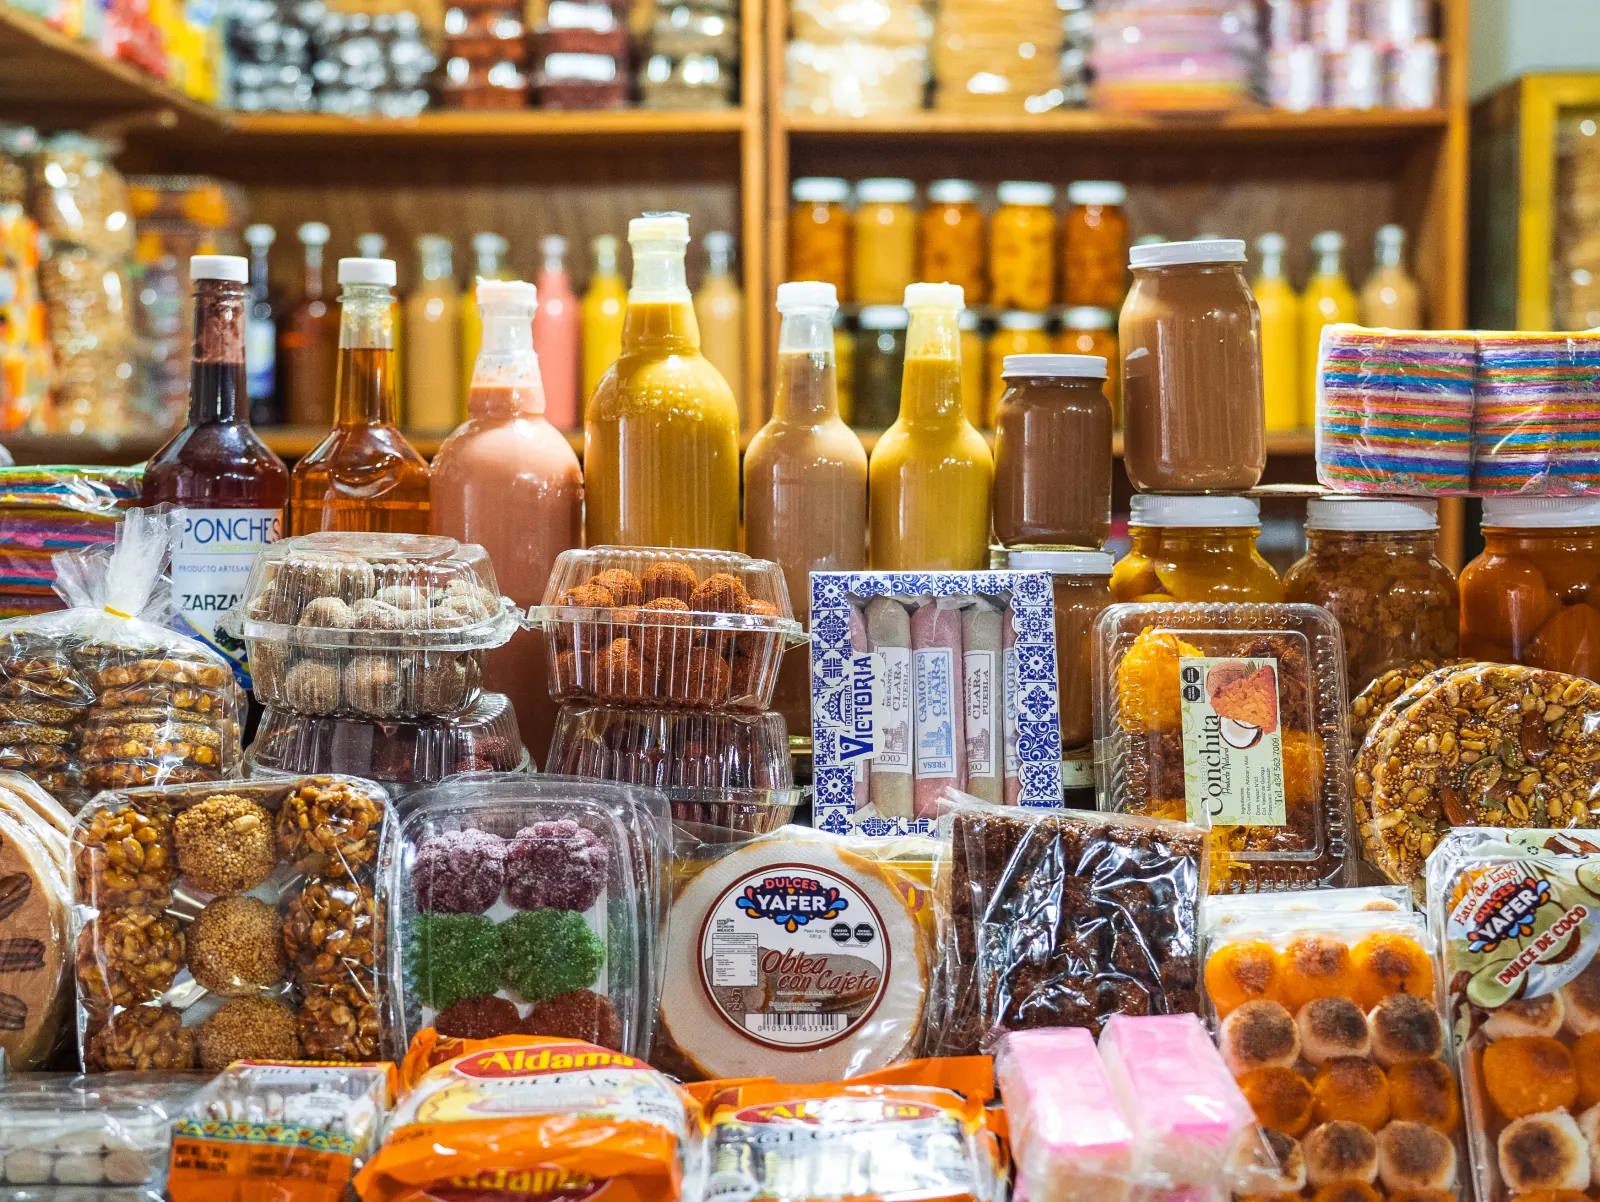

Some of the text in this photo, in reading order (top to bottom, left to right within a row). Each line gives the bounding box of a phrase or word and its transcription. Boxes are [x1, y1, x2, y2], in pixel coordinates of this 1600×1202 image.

[180, 518, 281, 549] PONCHES
[178, 565, 217, 573] PRODUCTO
[182, 594, 245, 611] ZARZA
[892, 660, 902, 711] CLARA
[918, 655, 927, 723] CAMOTES
[931, 656, 942, 717] CLARA
[940, 656, 948, 716] PUEBLA
[972, 668, 981, 720] CLARA
[1007, 651, 1016, 720] CAMOTES
[840, 655, 875, 762] VICTORIA
[886, 696, 892, 707] DE
[927, 696, 932, 706] DE
[967, 704, 972, 717] DE
[880, 754, 900, 763] COCO
[922, 760, 946, 769] FRESA
[1198, 714, 1223, 816] Conchita
[1219, 746, 1233, 796] Producto Natural
[1271, 737, 1283, 805] Tel. 434 562 7009
[765, 877, 818, 891] DULCES
[1474, 880, 1489, 897] de
[1487, 867, 1518, 885] Lujo
[757, 894, 827, 911] YAFER
[1474, 882, 1517, 923] DULCES
[1478, 889, 1539, 940] YAFER
[1498, 948, 1538, 985] DULCE
[1535, 932, 1556, 952] DE
[1551, 906, 1588, 937] COCO
[761, 947, 828, 975] Oblea
[730, 987, 742, 1002] 5
[777, 971, 877, 995] con Cajeta
[478, 1050, 635, 1071] Aldama
